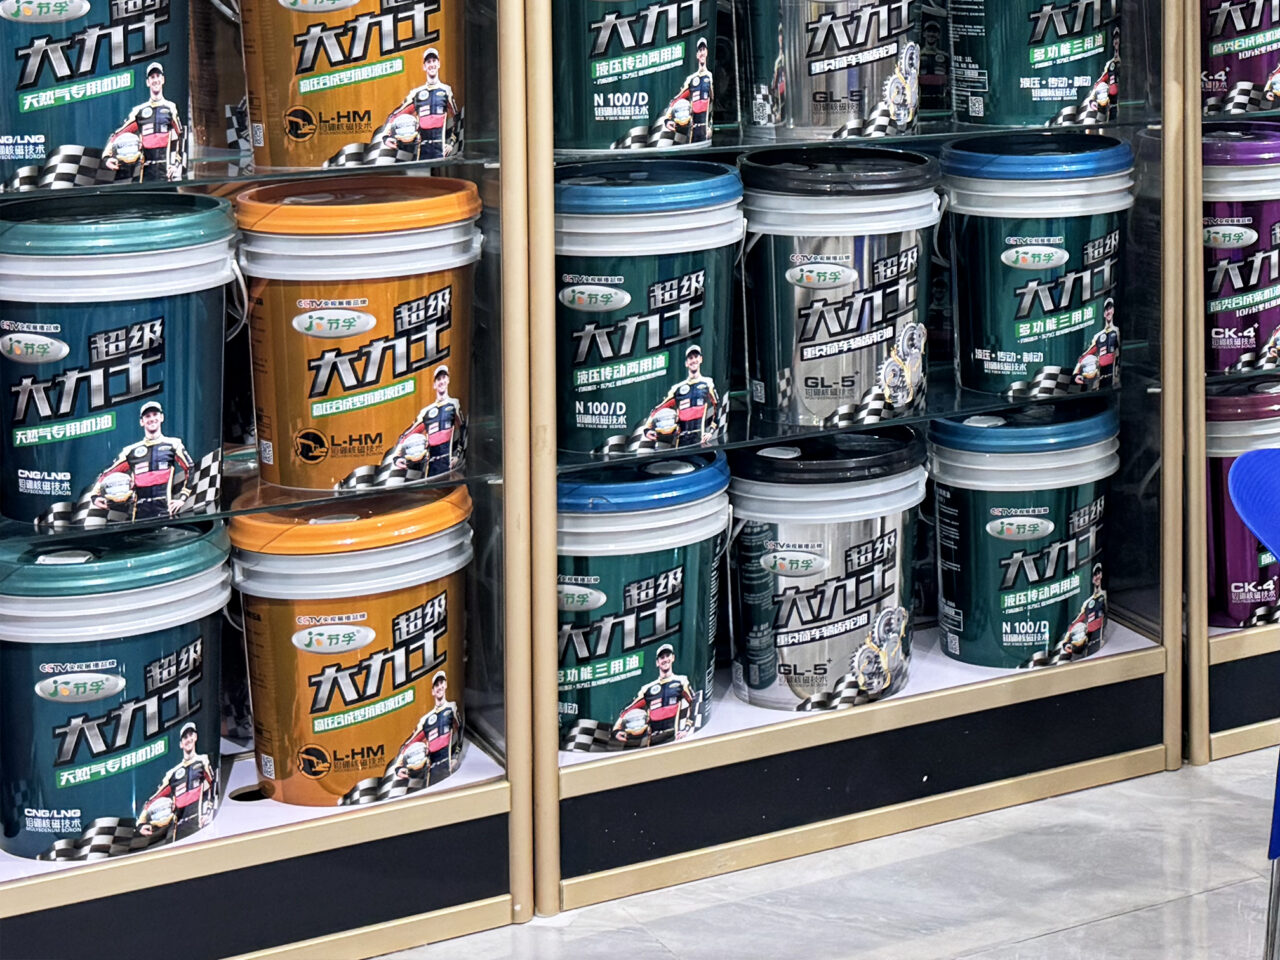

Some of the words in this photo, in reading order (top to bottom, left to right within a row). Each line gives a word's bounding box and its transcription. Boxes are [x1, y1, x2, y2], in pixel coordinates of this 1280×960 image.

[37, 1, 70, 15] 节孚
[15, 14, 170, 90] 大力士
[294, 3, 440, 75] 大力士
[1033, 34, 1103, 61] 多功能三用油
[596, 45, 683, 77] 液压传动两用油
[23, 72, 131, 110] 天然气专用机油
[594, 94, 603, 106] N
[608, 93, 648, 105] 100/D
[320, 110, 372, 123] L-HM
[1031, 253, 1055, 263] 节孚
[1083, 230, 1119, 264] 超级
[816, 271, 842, 283] 节孚
[873, 245, 918, 283] 超级
[587, 293, 614, 304] 节孚
[649, 269, 705, 309] 超级
[1015, 258, 1118, 320] 大力士
[327, 317, 357, 330] 节孚
[394, 285, 451, 333] 超级
[798, 276, 917, 343] 大力士
[1019, 307, 1094, 337] 多功能三用油
[89, 316, 165, 363] 超级
[573, 300, 704, 364] 大力士
[23, 343, 50, 355] 节孚
[308, 321, 451, 398] 大力士
[577, 355, 665, 384] 液压传动两用油
[10, 353, 165, 423] 大力士
[576, 401, 583, 413] N
[588, 402, 626, 415] 100/D
[15, 414, 113, 444] 天然气专用机油
[331, 433, 382, 446] L-HM
[18, 470, 71, 480] CNG/LNG
[1016, 523, 1040, 534] 节孚
[1069, 496, 1105, 535] 超级
[789, 558, 814, 570] 节孚
[845, 528, 897, 573] 超级
[1001, 524, 1104, 590] 大力士
[624, 566, 684, 610] 超级
[772, 563, 897, 631] 大力士
[1004, 576, 1080, 607] 液压传动两用油
[393, 591, 448, 640] 超级
[1003, 622, 1010, 633] N
[1014, 621, 1049, 633] 100/D
[327, 632, 356, 645] 节孚
[145, 637, 203, 690] 超级
[309, 627, 448, 713] 大力士
[74, 681, 105, 695] 节孚
[53, 672, 203, 766] 大力士
[61, 740, 165, 785] 天然气专用机油
[333, 745, 385, 760] L-HM
[24, 808, 81, 817] CNG/LNG
